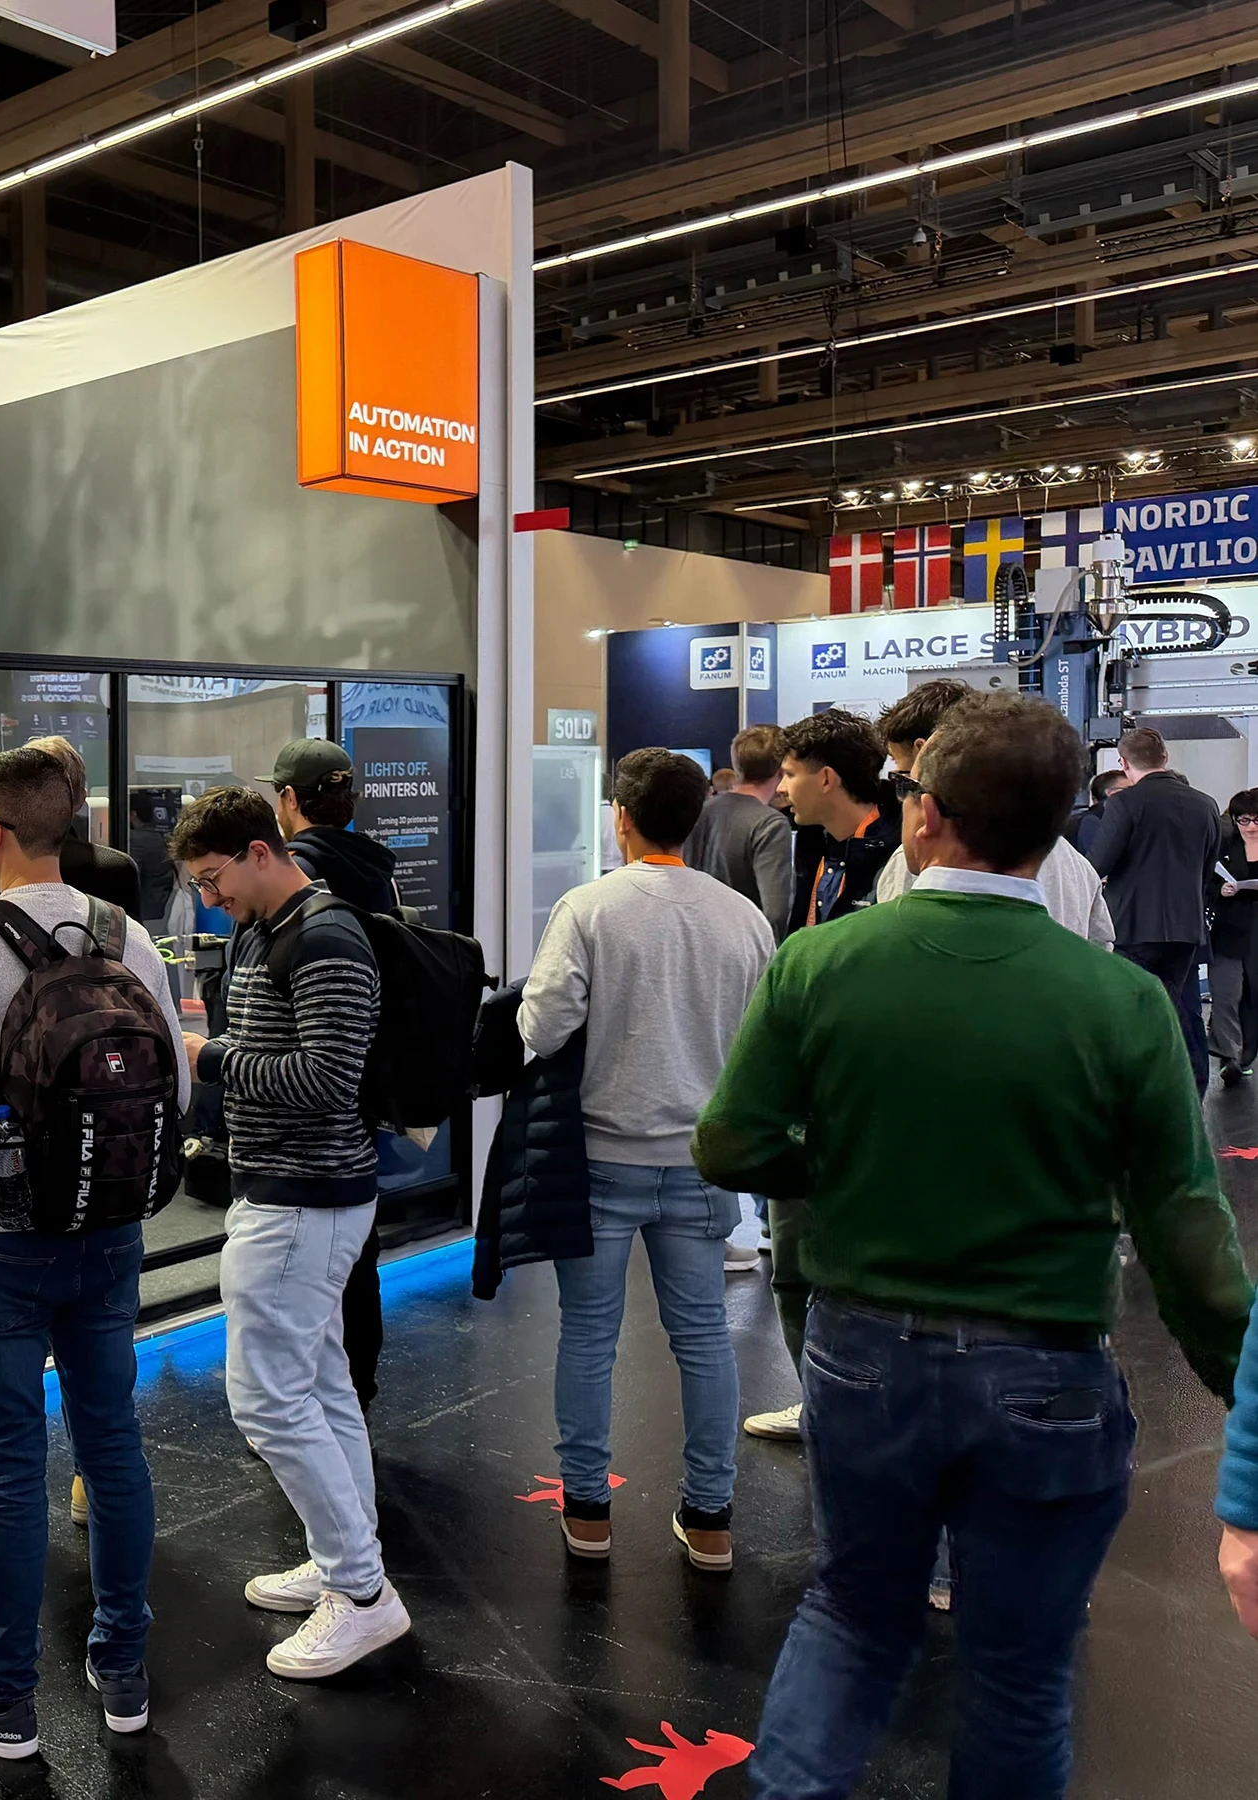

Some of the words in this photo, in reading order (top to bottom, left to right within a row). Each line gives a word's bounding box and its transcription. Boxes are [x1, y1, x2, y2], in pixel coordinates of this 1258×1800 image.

[348, 401, 475, 445] AUTOMATION
[348, 431, 369, 455] IN
[372, 437, 445, 467] ACTION
[1116, 493, 1250, 533] NORDIC
[863, 634, 969, 661] LARGE
[699, 671, 732, 681] FANUM
[811, 670, 847, 679] FANUM
[1058, 659, 1070, 673] ST
[554, 716, 592, 740] SOLD
[364, 762, 405, 777] LIGHTS
[407, 762, 431, 776] OFF.
[364, 782, 418, 798] PRINTERS
[420, 781, 439, 797] ON.
[377, 817, 398, 826] Turning
[81, 1128, 94, 1162] FILA
[76, 1180, 91, 1209] FILA
